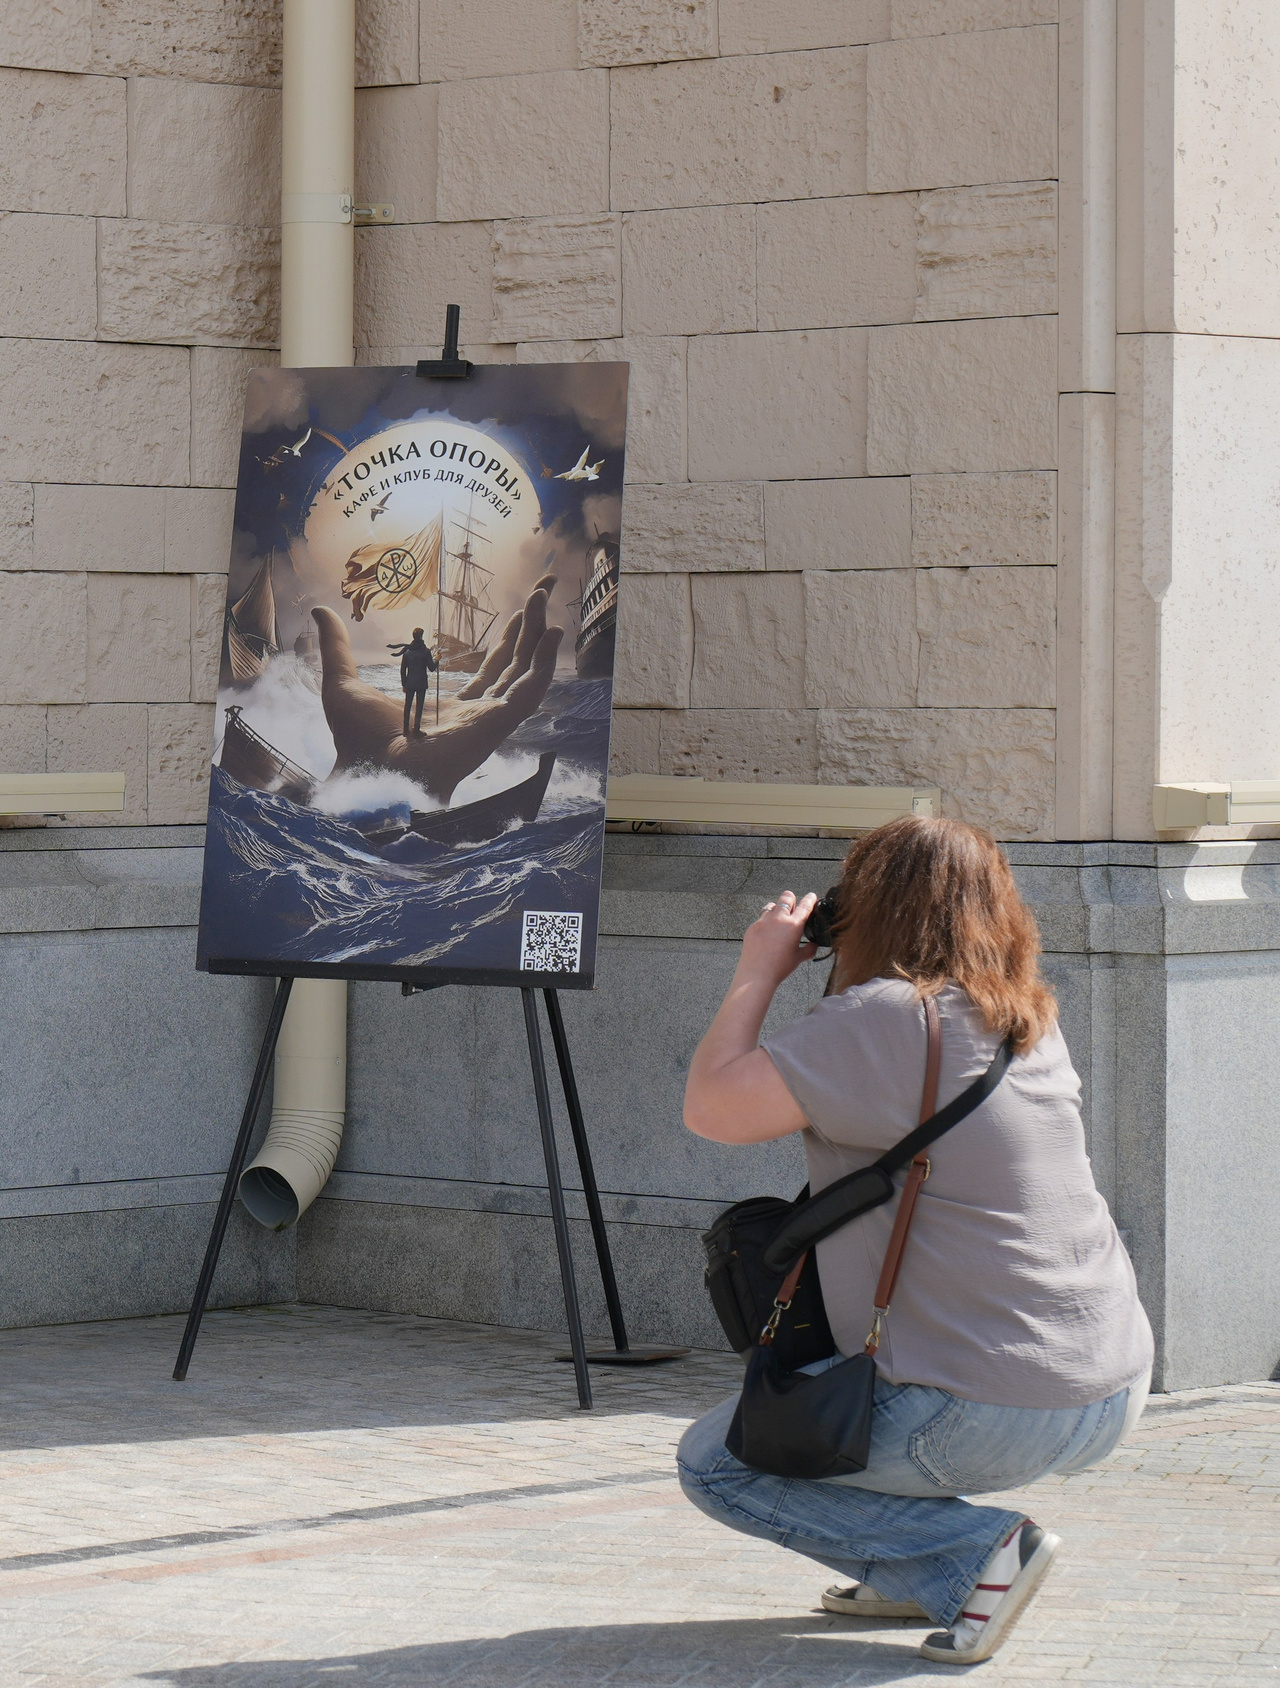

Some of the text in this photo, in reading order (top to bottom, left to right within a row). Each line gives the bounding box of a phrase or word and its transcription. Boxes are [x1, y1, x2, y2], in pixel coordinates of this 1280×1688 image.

[334, 440, 521, 500] «ТОЧКА ОПОРЫ»
[343, 468, 512, 518] КАФЕ И КЛУБ ДЛЯ ДРУЗЕЙ
